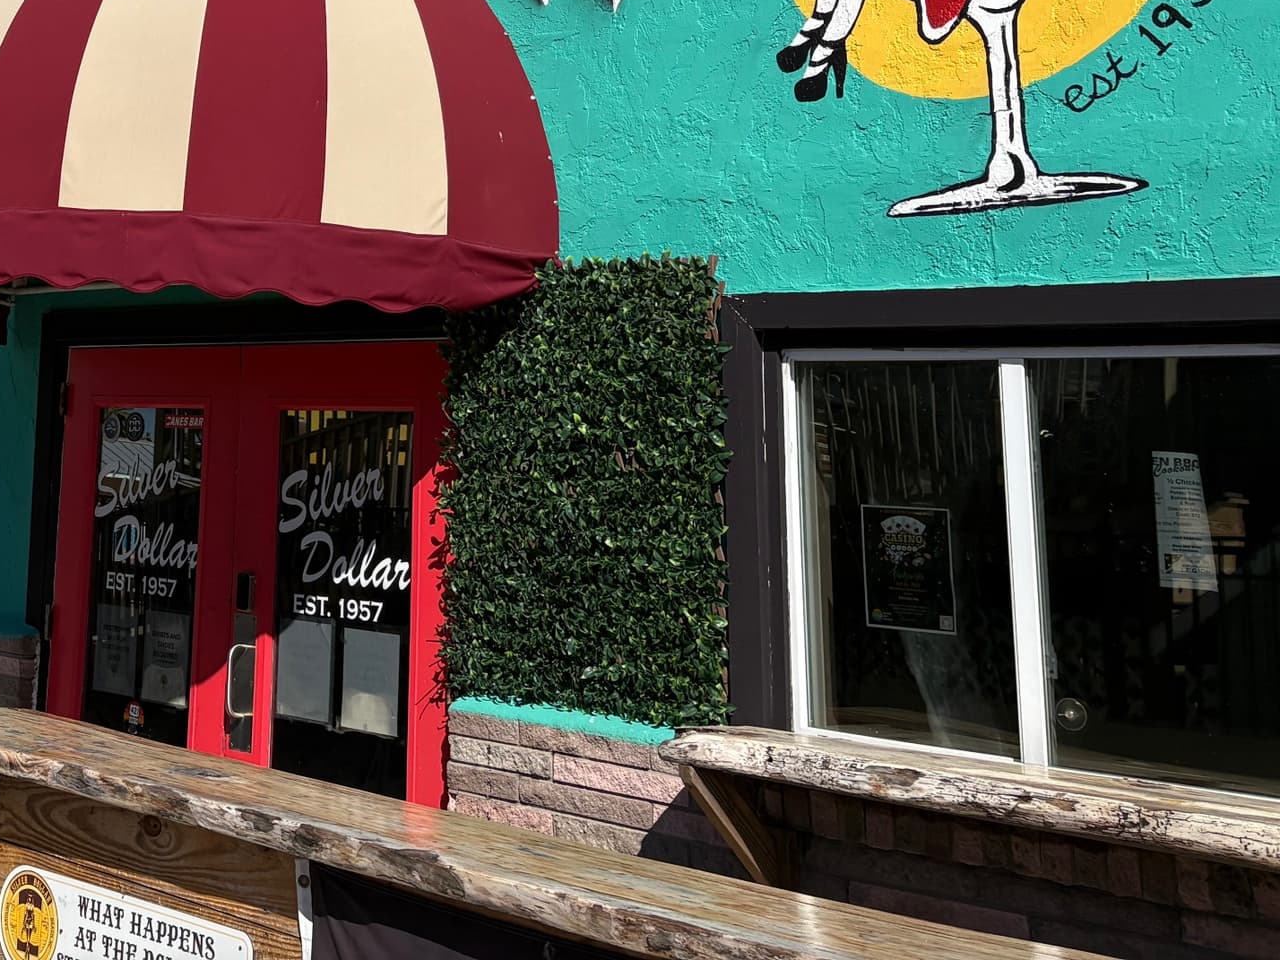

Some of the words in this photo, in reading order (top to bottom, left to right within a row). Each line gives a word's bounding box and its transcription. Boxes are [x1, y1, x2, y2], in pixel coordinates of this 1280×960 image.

[1064, 49, 1146, 113] est.
[95, 456, 181, 518] Silver
[279, 461, 384, 534] Silver
[114, 515, 200, 574] Dollar
[301, 530, 411, 591] Dollar
[106, 571, 136, 594] EST.
[141, 576, 177, 598] 1957
[293, 593, 331, 618] EST.
[338, 597, 384, 623] 1957
[74, 926, 96, 952] AT
[102, 934, 137, 960] THE
[78, 895, 125, 930] WHAT
[130, 911, 216, 960] HAPPENS
